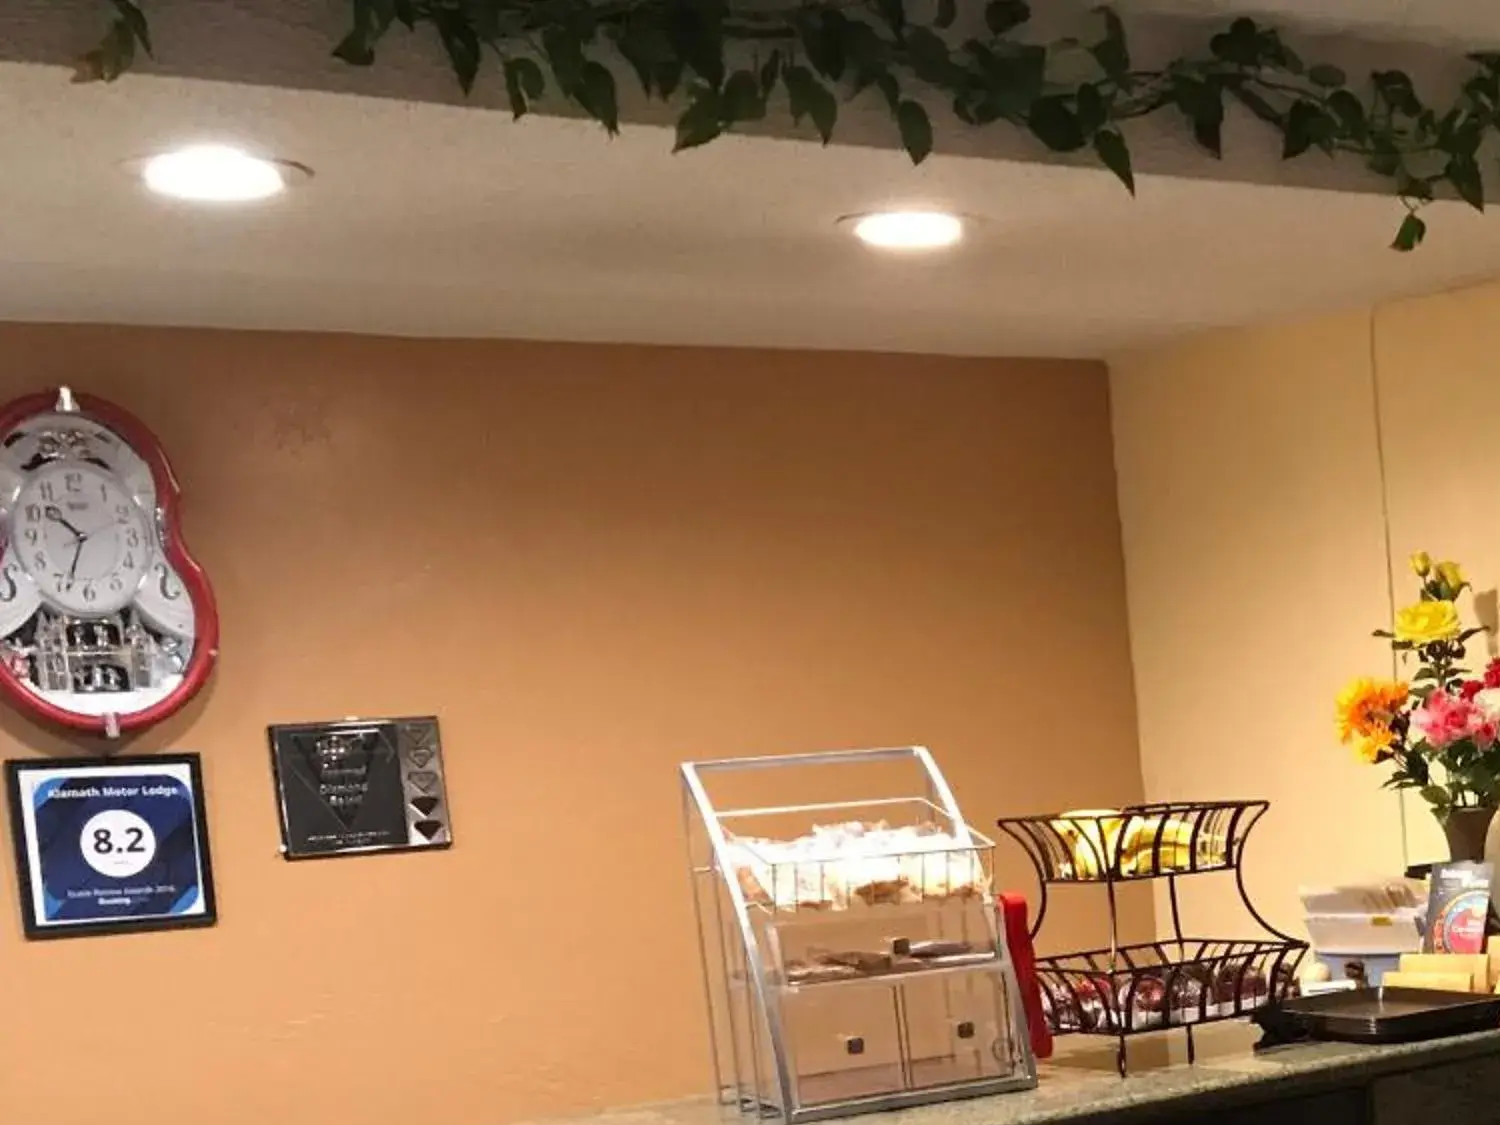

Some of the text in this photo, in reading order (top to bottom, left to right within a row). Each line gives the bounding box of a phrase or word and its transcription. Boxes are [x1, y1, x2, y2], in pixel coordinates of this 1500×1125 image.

[40, 481, 54, 501] 11
[24, 528, 38, 546] 9
[126, 527, 139, 548] 3
[122, 551, 134, 569] 4
[48, 784, 178, 799] Klamath Motor Lodge
[93, 826, 146, 854] 8.2
